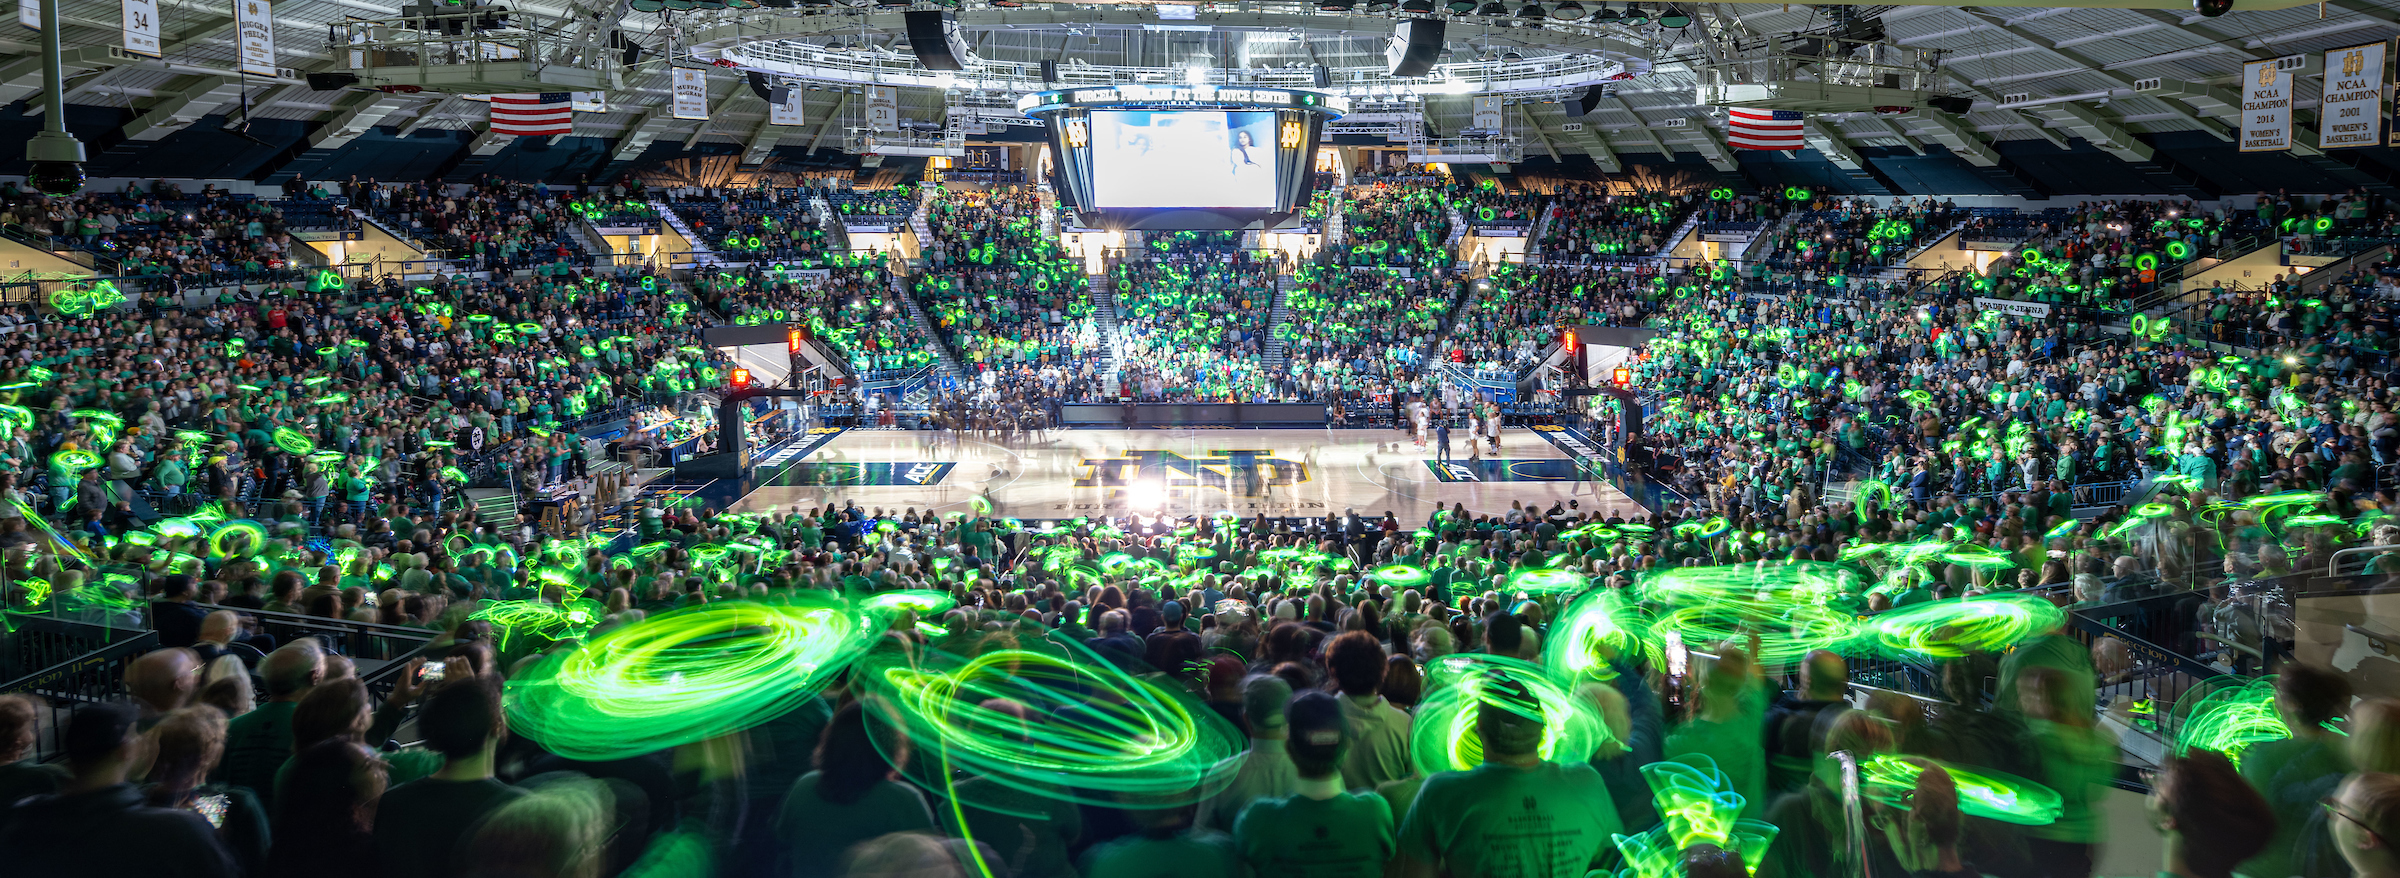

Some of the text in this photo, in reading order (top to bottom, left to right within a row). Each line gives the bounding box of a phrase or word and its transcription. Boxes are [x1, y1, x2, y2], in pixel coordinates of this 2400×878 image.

[133, 11, 149, 31] 34
[241, 21, 269, 34] DIGGER
[243, 30, 269, 42] PHELPS
[676, 84, 703, 92] MUFFET
[2336, 79, 2367, 91] NCAA
[1074, 90, 1118, 102] PURCELL
[1174, 89, 1191, 101] AT
[1217, 89, 1251, 101] JOYCE
[1253, 90, 1291, 103] CENTER
[2253, 89, 2279, 100] NCAA
[2325, 89, 2380, 104] CHAMPION
[780, 102, 794, 113] 20
[2243, 99, 2288, 111] CHAMPION
[876, 109, 888, 119] 21
[2340, 107, 2360, 118] 2001
[2256, 114, 2275, 124] 2018
[2249, 128, 2281, 138] WOMEN'S
[2332, 122, 2369, 133] WOMEN'S
[2245, 138, 2285, 148] BASKETBALL
[2325, 133, 2373, 144] BASKETBALL
[1979, 301, 2044, 315] MADDY JENNA
[903, 462, 938, 484] ACC
[1053, 503, 1184, 511] PURCL
[2119, 637, 2180, 667] section 9
[72, 661, 83, 674] 11
